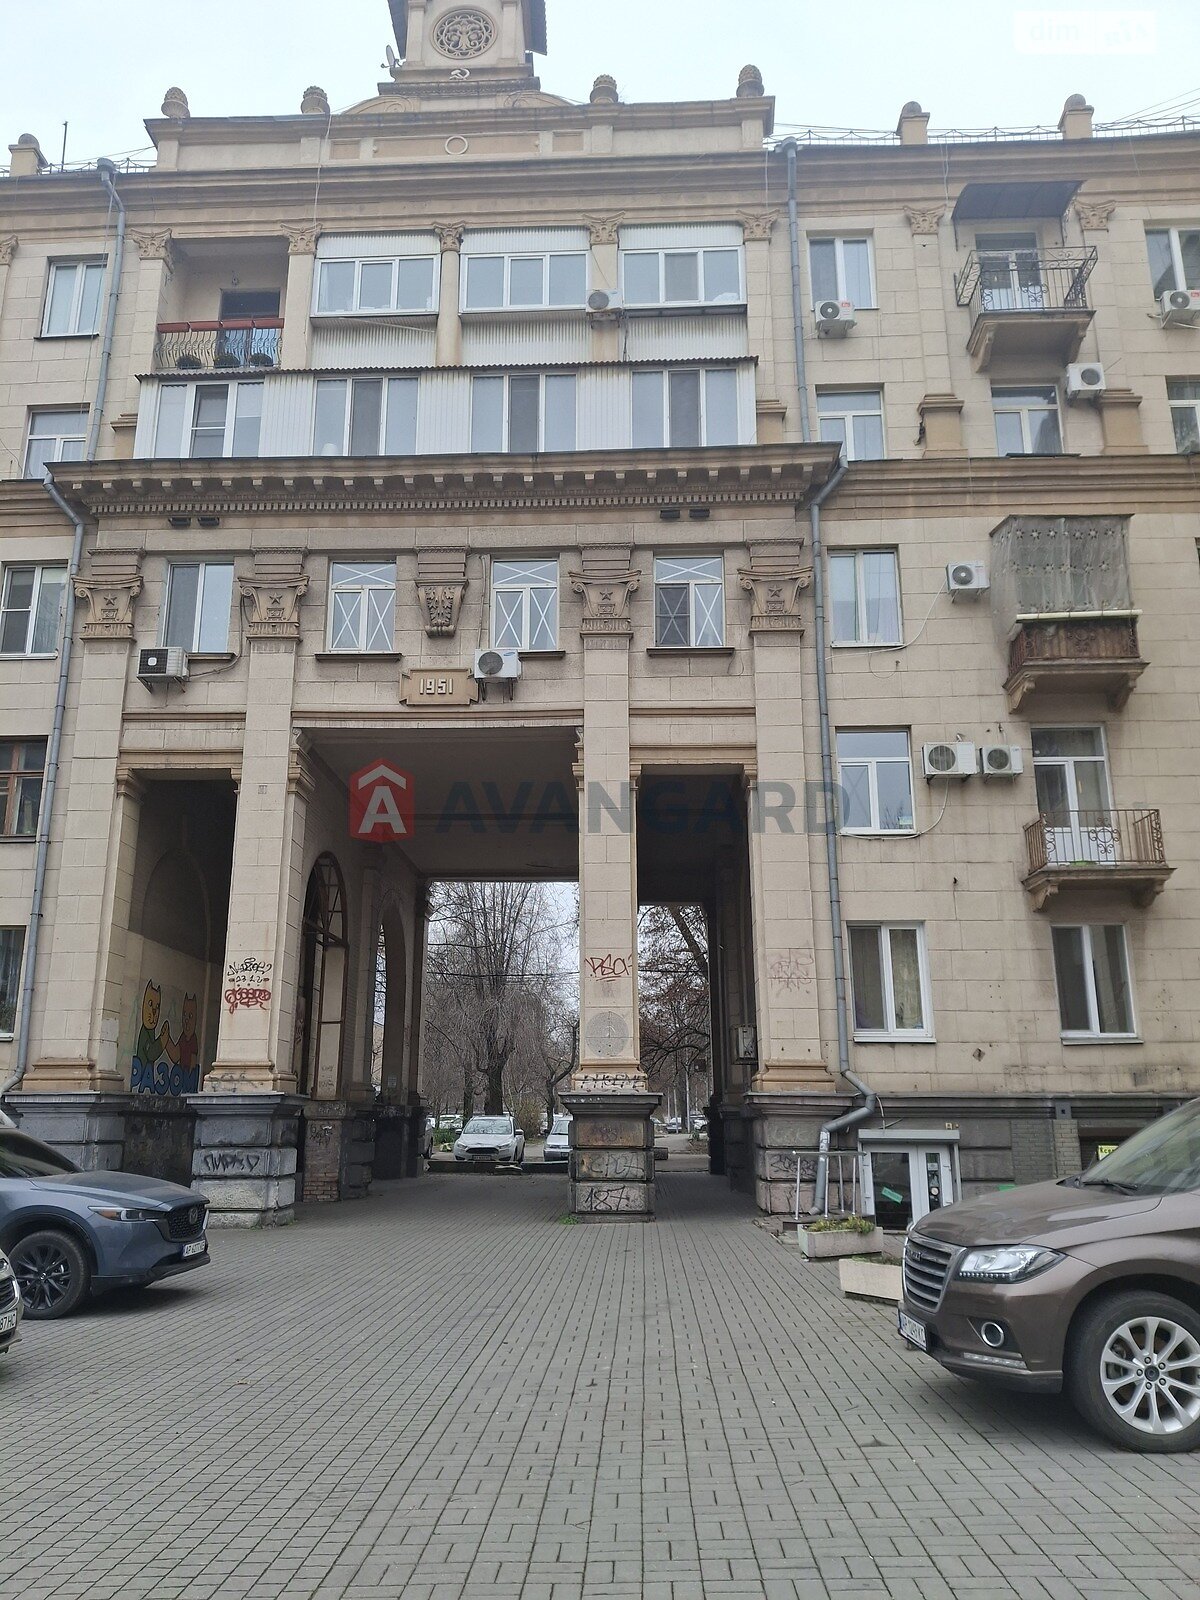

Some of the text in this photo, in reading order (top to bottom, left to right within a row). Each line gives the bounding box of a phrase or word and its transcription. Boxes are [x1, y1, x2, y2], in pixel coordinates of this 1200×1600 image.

[420, 678, 454, 695] 1951
[130, 1055, 201, 1096] РАЗОМ
[585, 1185, 630, 1211] 187
